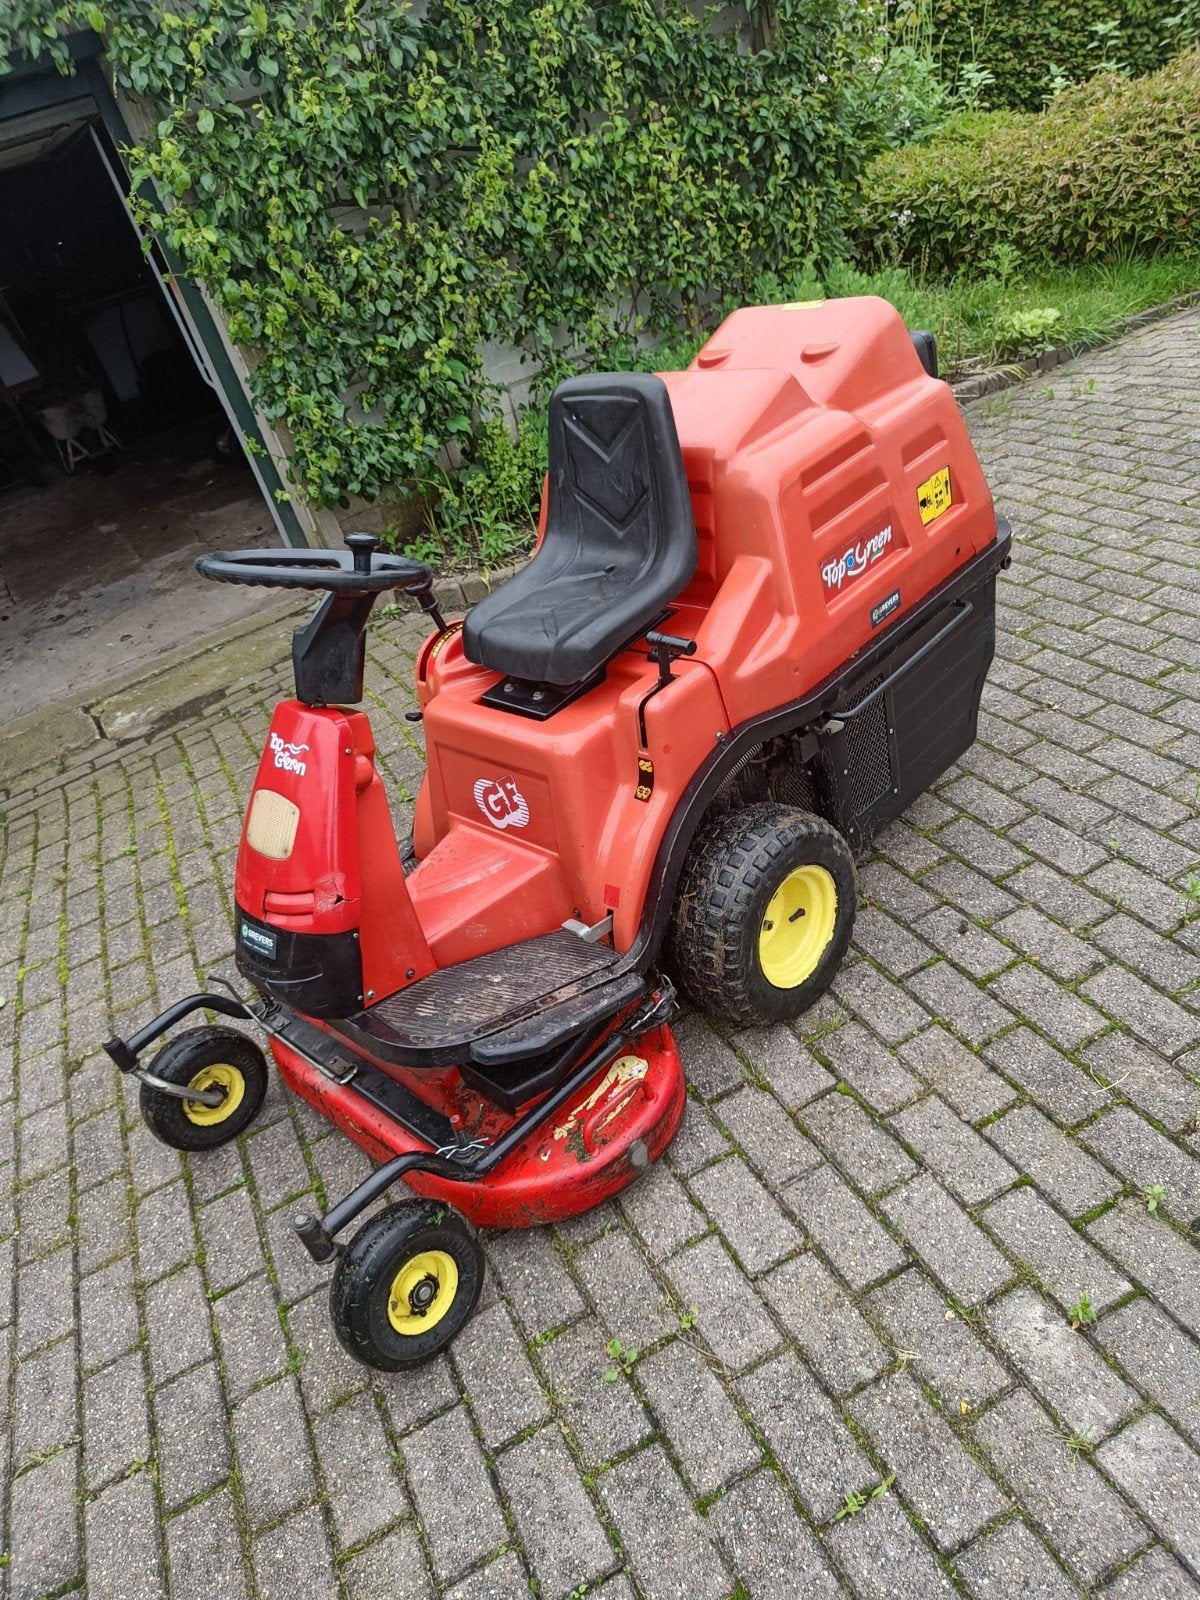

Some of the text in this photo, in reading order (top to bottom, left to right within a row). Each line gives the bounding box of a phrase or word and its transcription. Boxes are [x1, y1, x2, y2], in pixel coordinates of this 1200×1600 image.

[822, 525, 892, 589] Top Green
[269, 732, 285, 755] Top
[274, 751, 307, 777] Green
